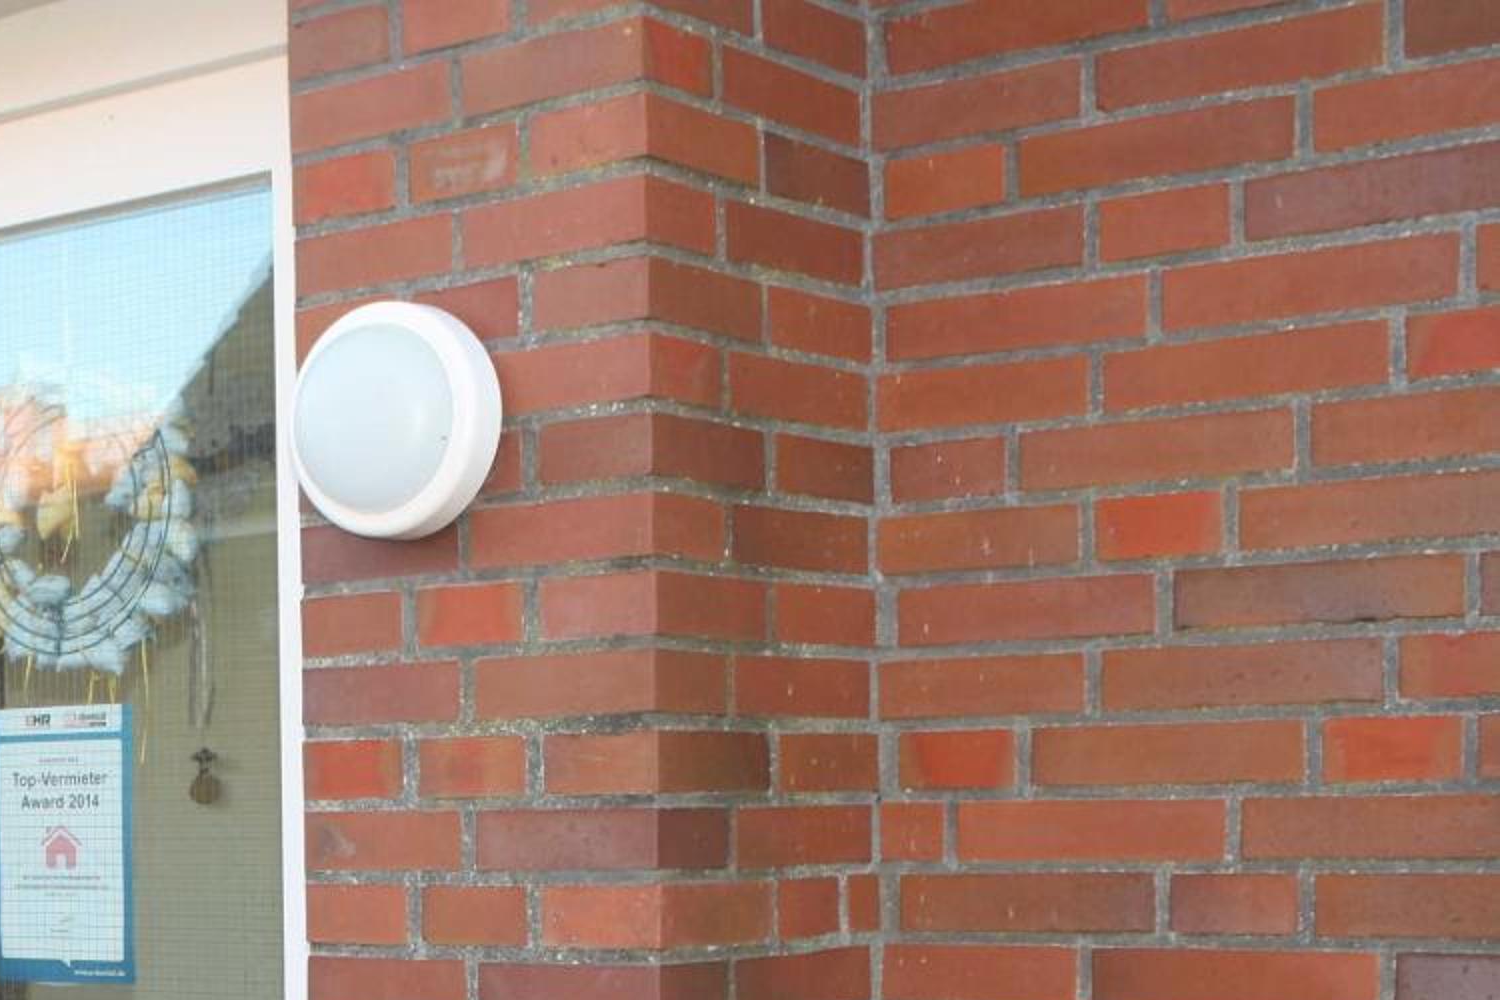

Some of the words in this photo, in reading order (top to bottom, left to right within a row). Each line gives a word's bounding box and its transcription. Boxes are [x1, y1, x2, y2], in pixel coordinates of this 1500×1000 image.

[12, 772, 107, 788] Top-Vermieter
[21, 794, 65, 810] Award
[69, 793, 100, 809] 2014
